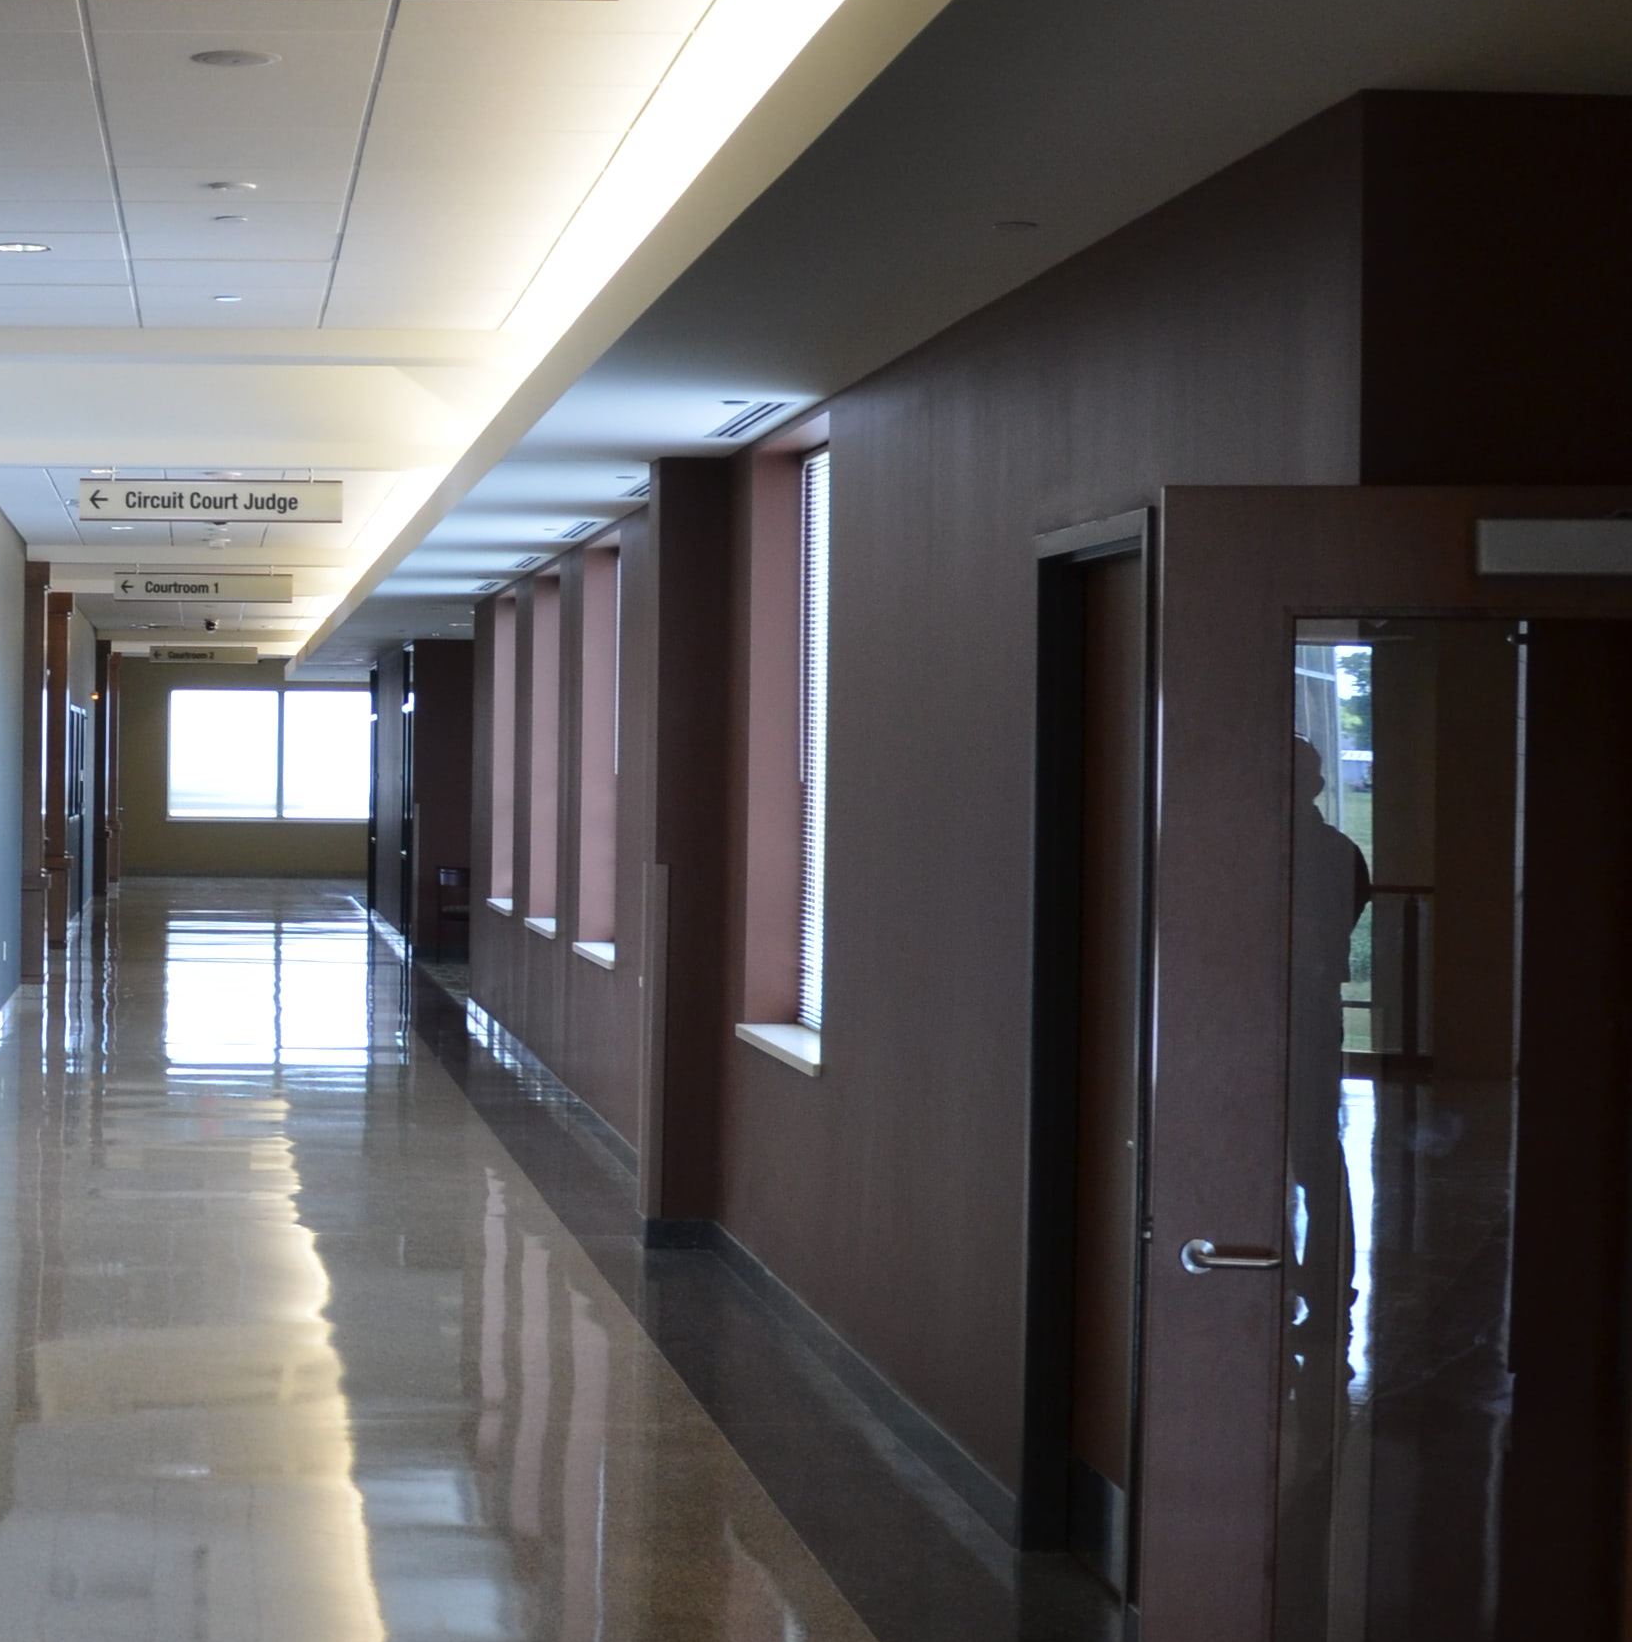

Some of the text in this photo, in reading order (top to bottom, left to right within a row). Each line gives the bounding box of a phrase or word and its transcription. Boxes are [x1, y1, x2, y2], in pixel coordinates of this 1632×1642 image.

[125, 491, 299, 514] Circuit Court Judge
[144, 581, 219, 594] Courtroom 1
